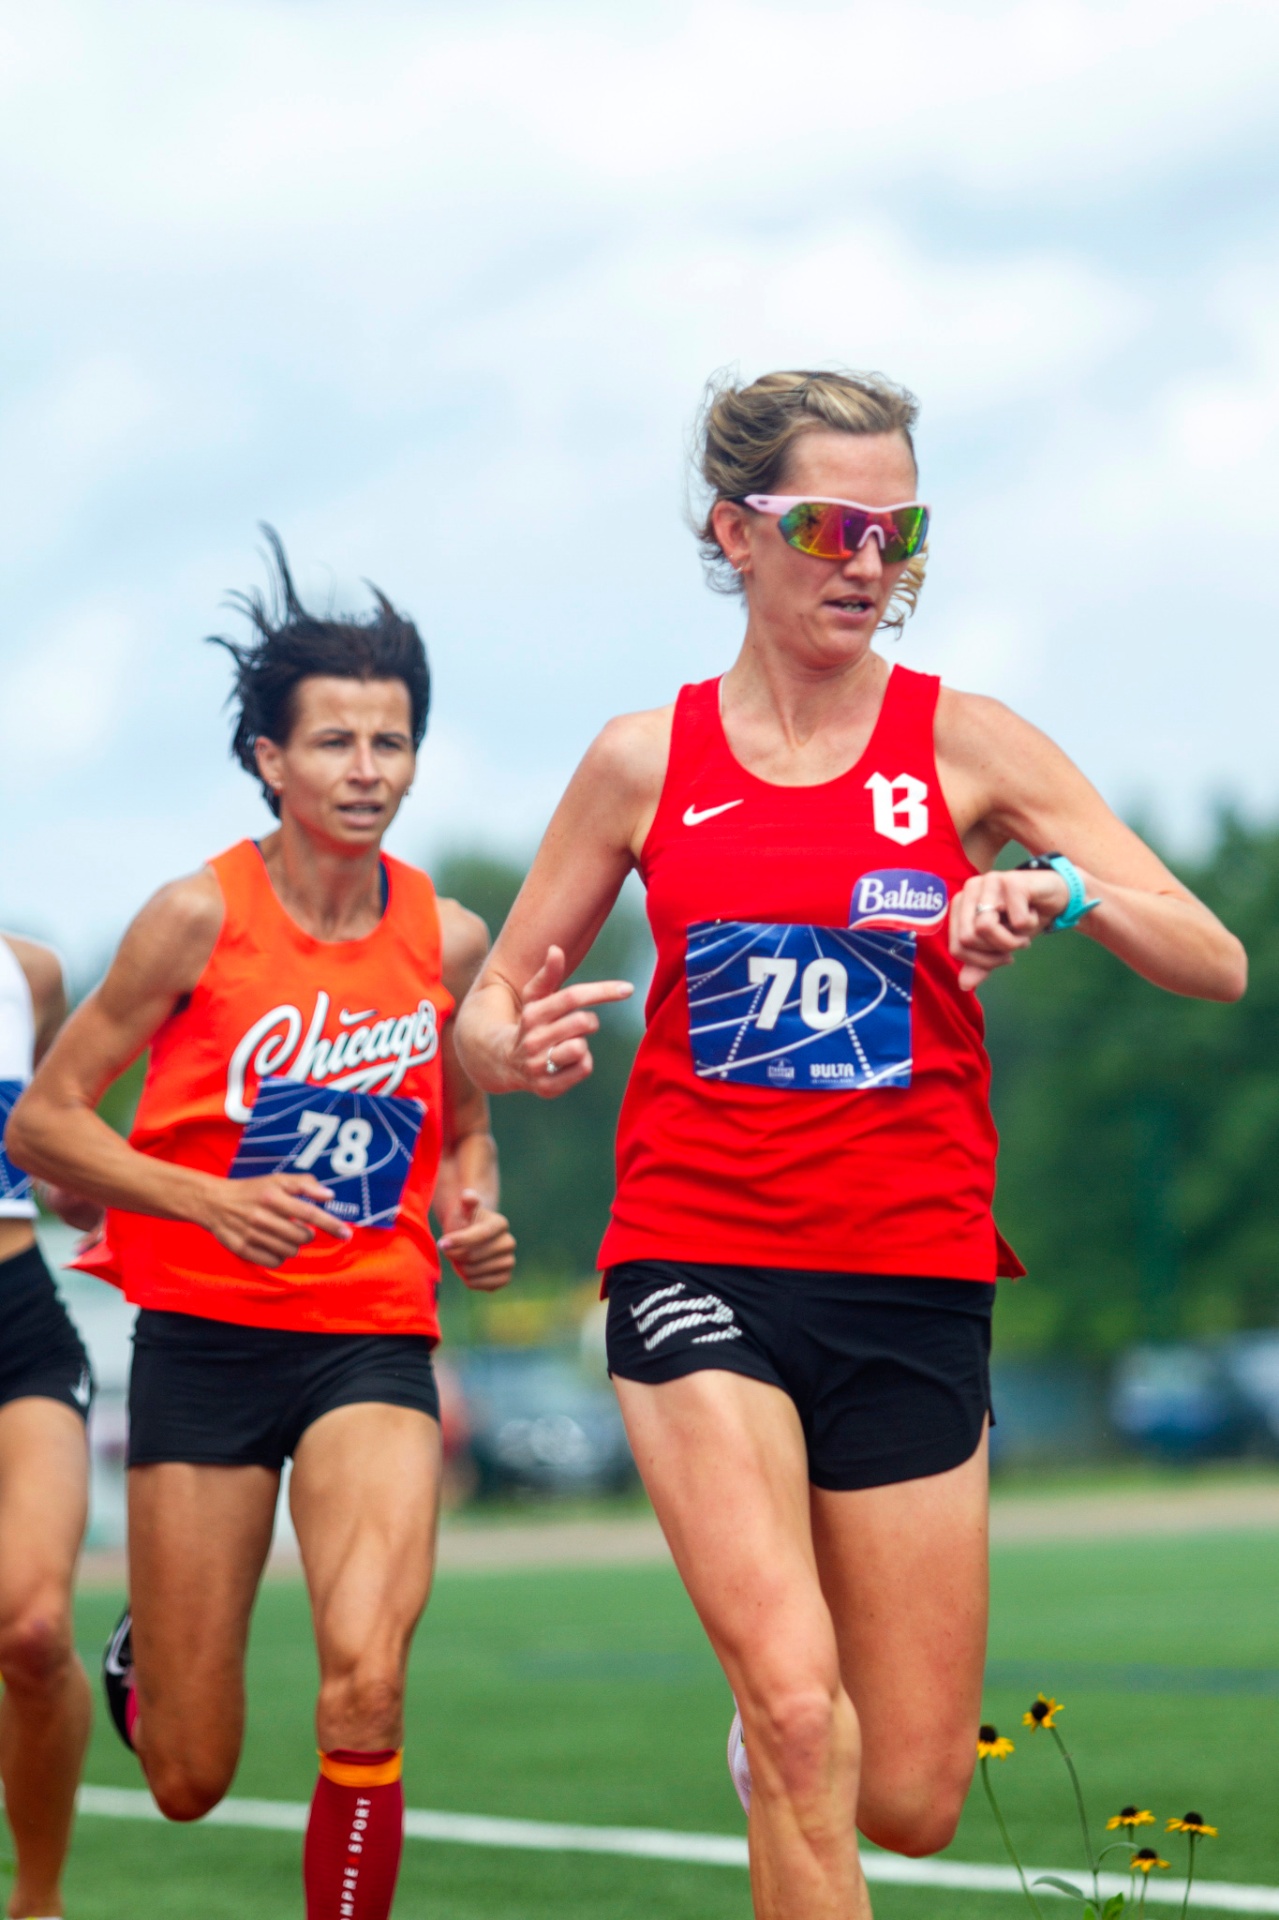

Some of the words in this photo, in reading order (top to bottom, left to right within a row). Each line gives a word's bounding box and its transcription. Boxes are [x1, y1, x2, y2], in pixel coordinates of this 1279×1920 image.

[864, 772, 928, 846] B
[857, 877, 943, 914] Baltais
[748, 956, 848, 1031] 70
[224, 990, 439, 1124] Chicago
[293, 1110, 373, 1177] 78
[348, 1797, 371, 1854] SPORT
[340, 1867, 358, 1920] MPRE
